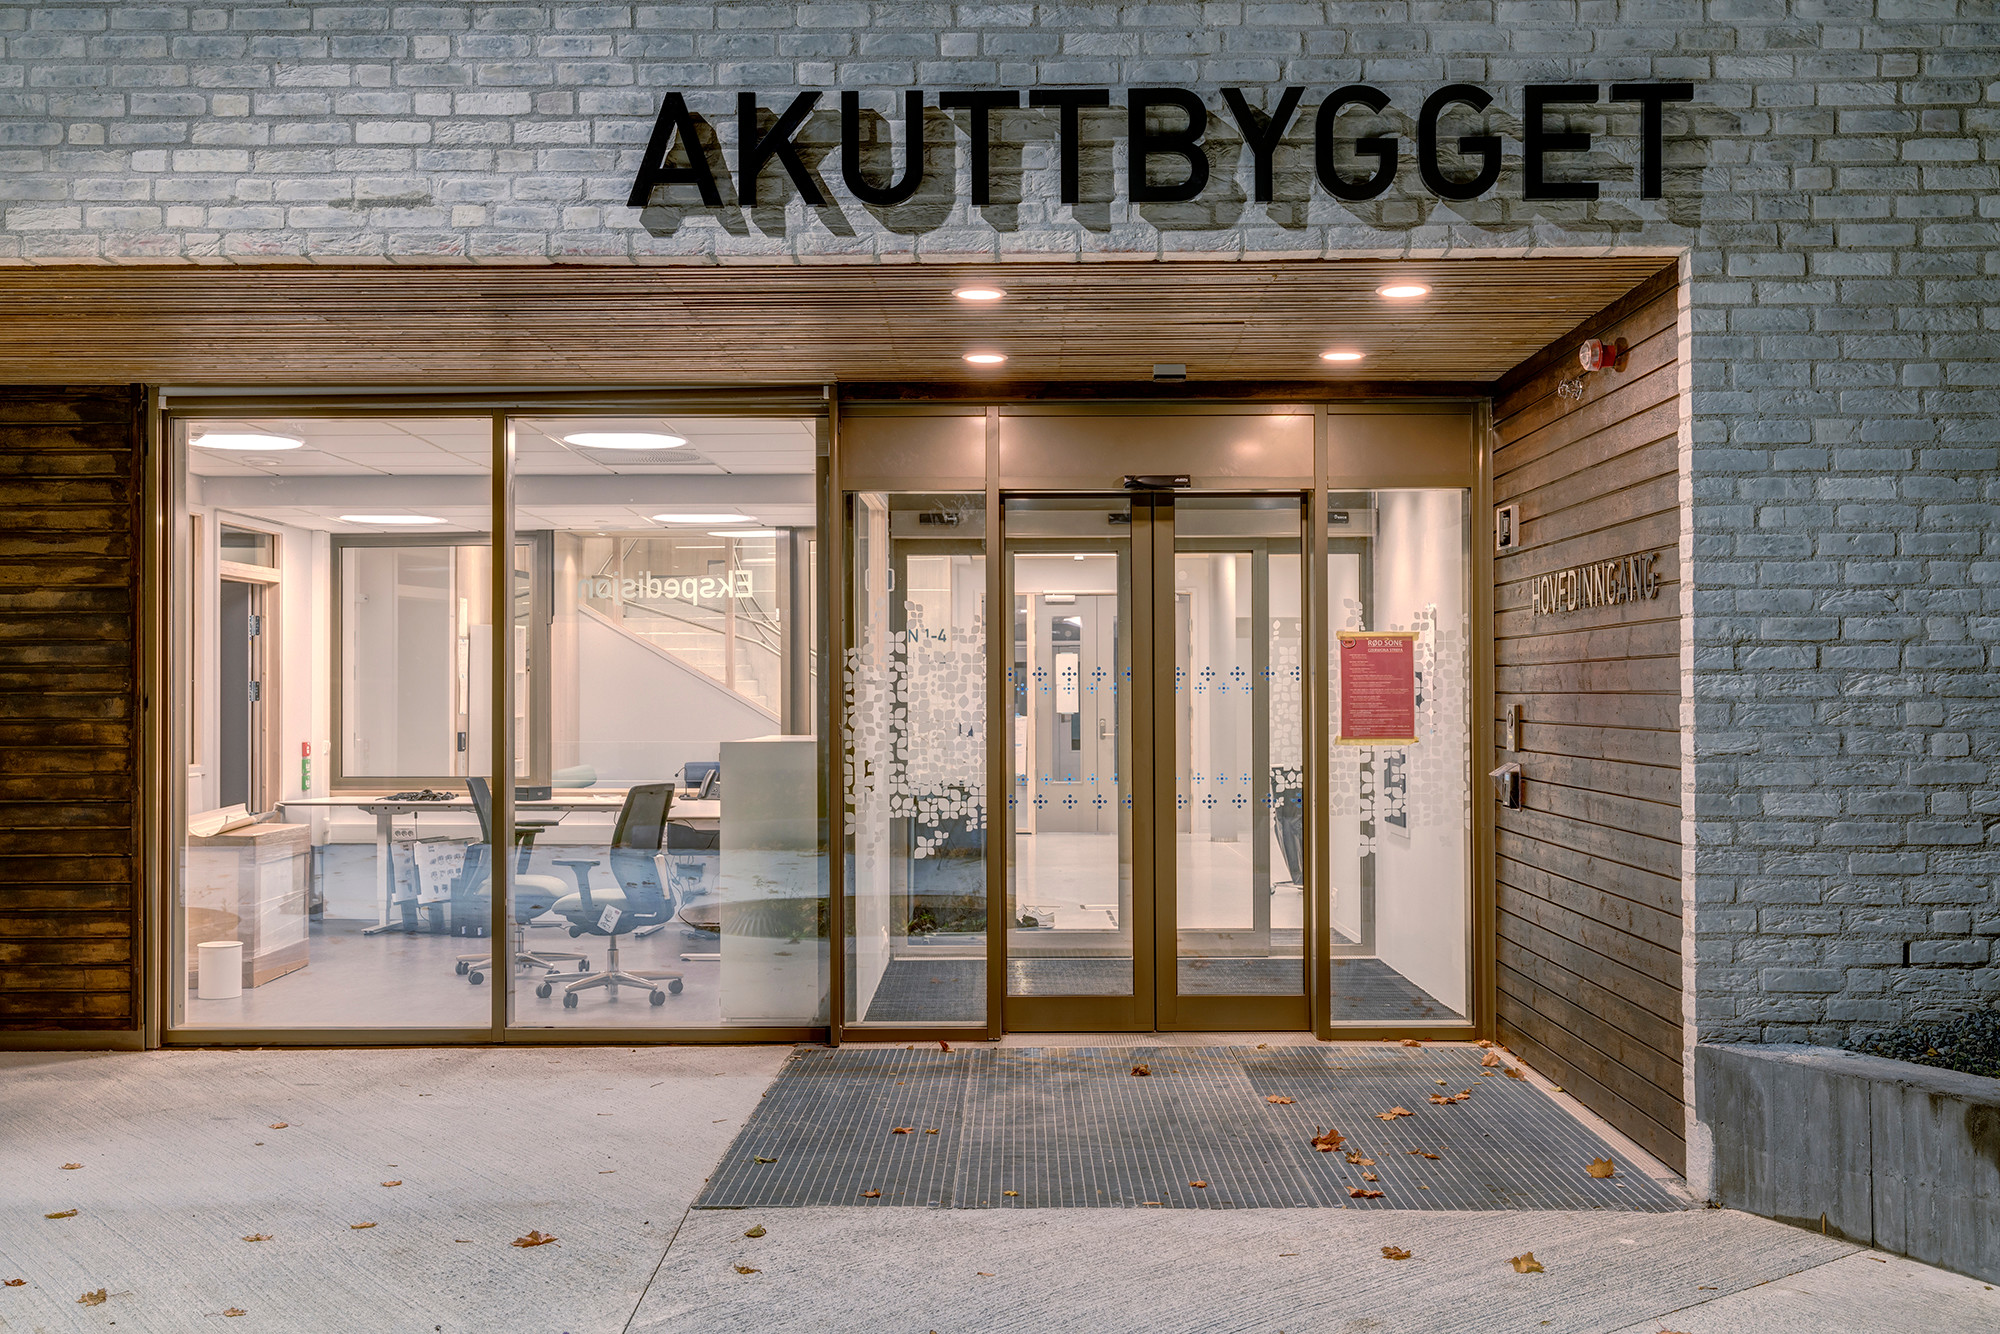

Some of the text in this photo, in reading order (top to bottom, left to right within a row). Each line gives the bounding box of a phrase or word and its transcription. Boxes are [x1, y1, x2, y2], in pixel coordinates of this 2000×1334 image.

[627, 83, 1694, 207] AKUTTBYGGET
[1531, 551, 1658, 617] HOVEDINNGANG
[908, 629, 918, 642] N
